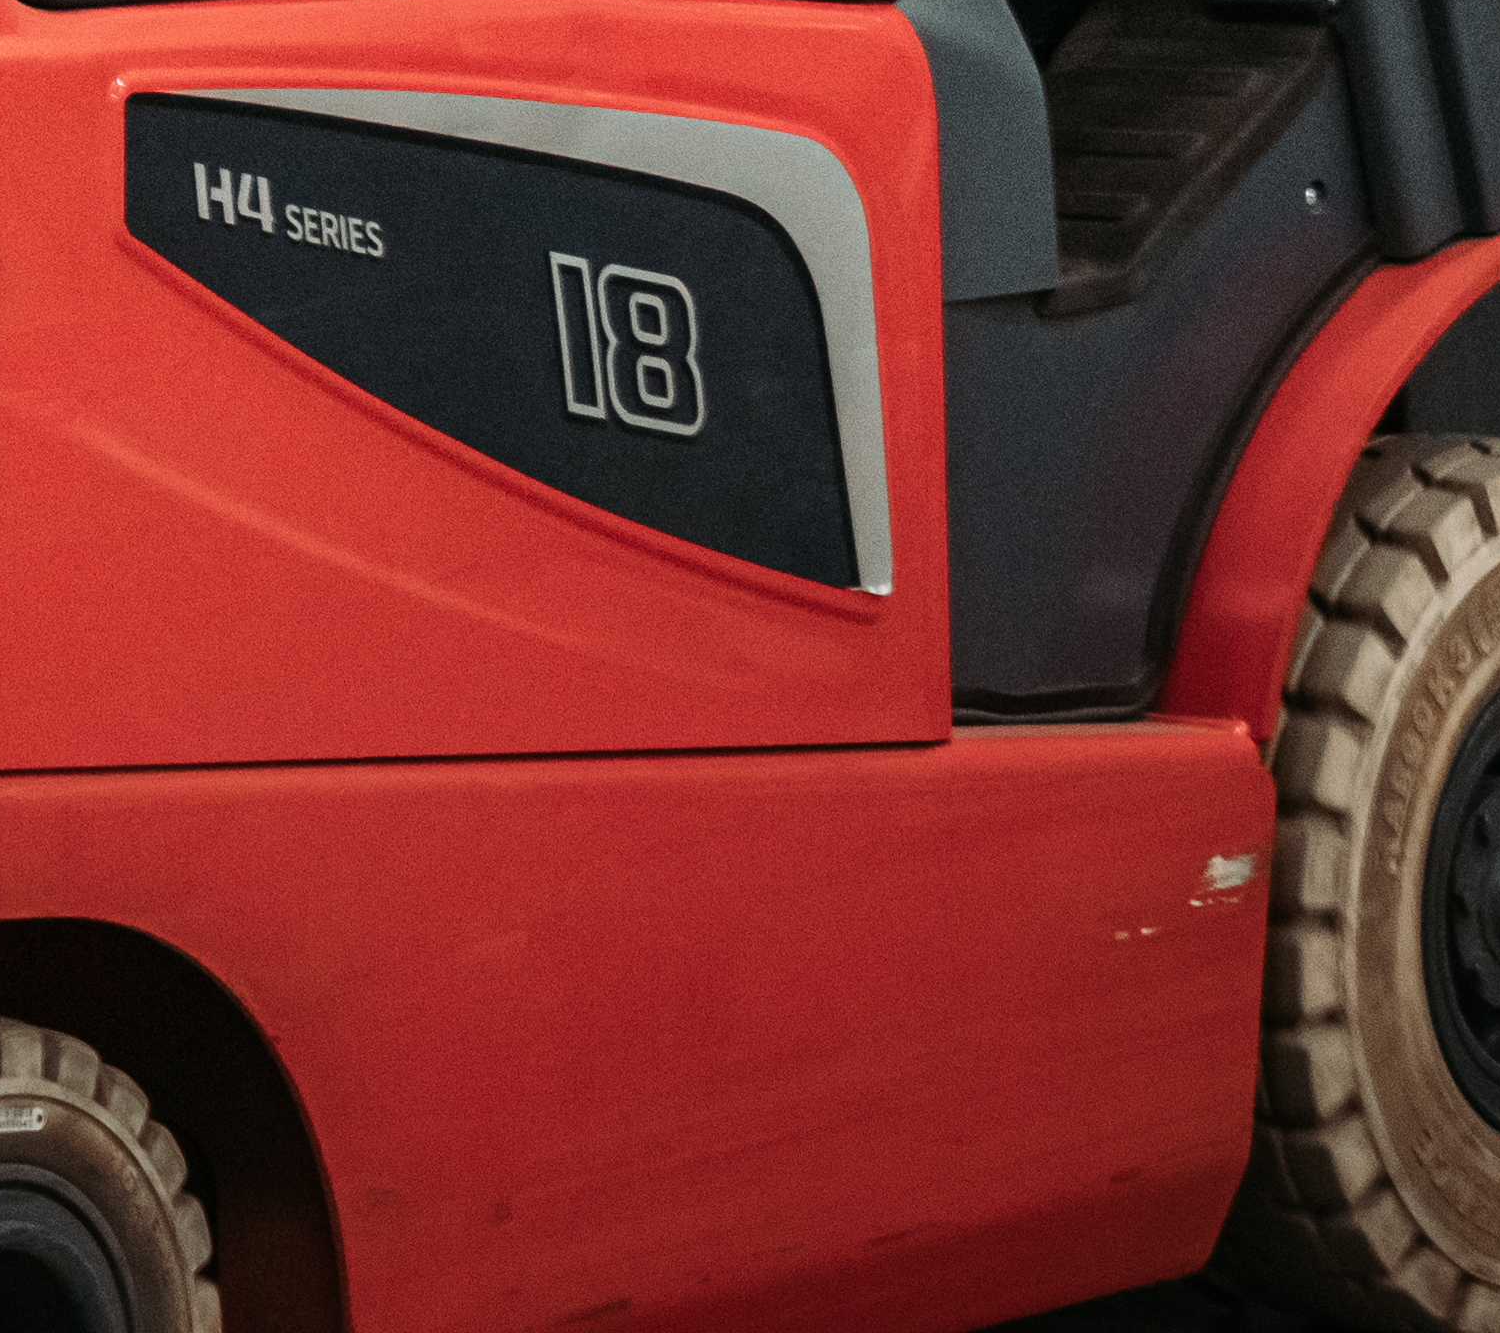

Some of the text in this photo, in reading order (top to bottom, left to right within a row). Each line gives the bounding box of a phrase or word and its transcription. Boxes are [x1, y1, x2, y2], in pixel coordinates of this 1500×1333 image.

[194, 161, 385, 258] H4 SERIES
[549, 250, 705, 436] 18
